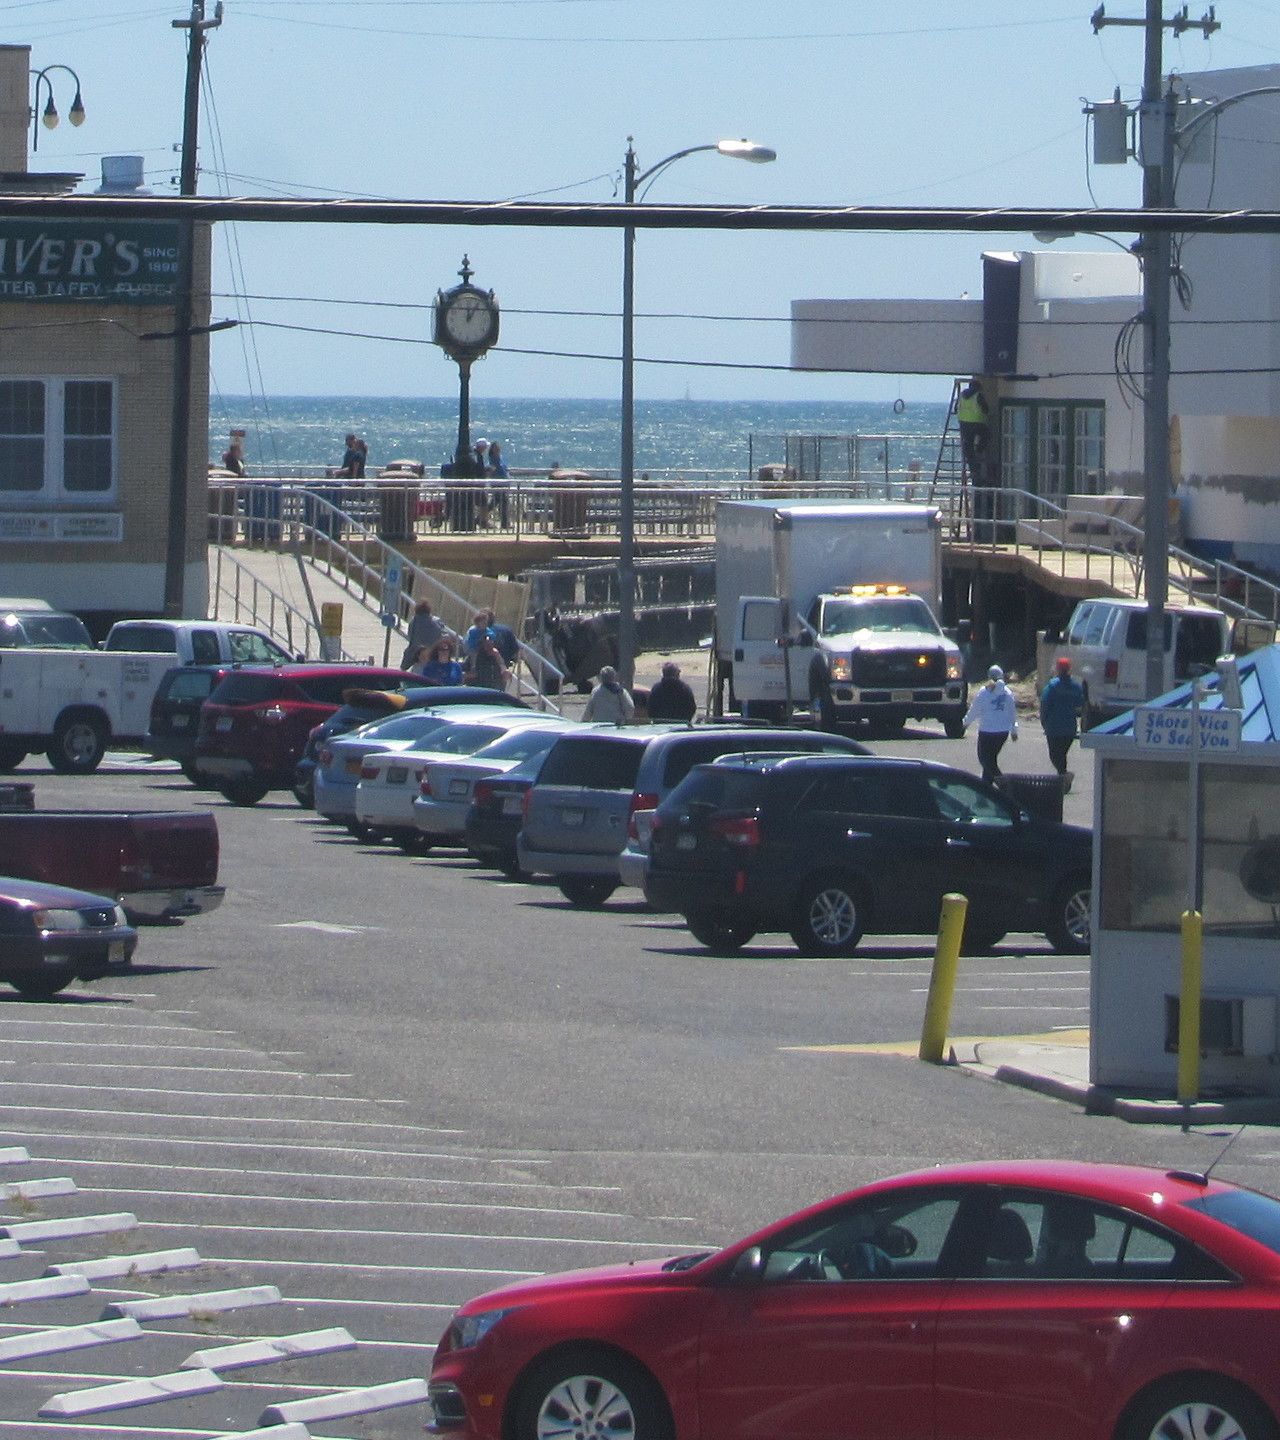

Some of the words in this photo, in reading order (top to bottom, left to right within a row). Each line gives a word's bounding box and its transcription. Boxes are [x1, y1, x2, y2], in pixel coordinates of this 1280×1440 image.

[46, 282, 101, 296] TAFFY
[1146, 712, 1189, 728] Shore
[1199, 715, 1229, 730] Nice
[1146, 729, 1162, 743] To
[1168, 730, 1192, 745] See
[1200, 732, 1229, 748] You
